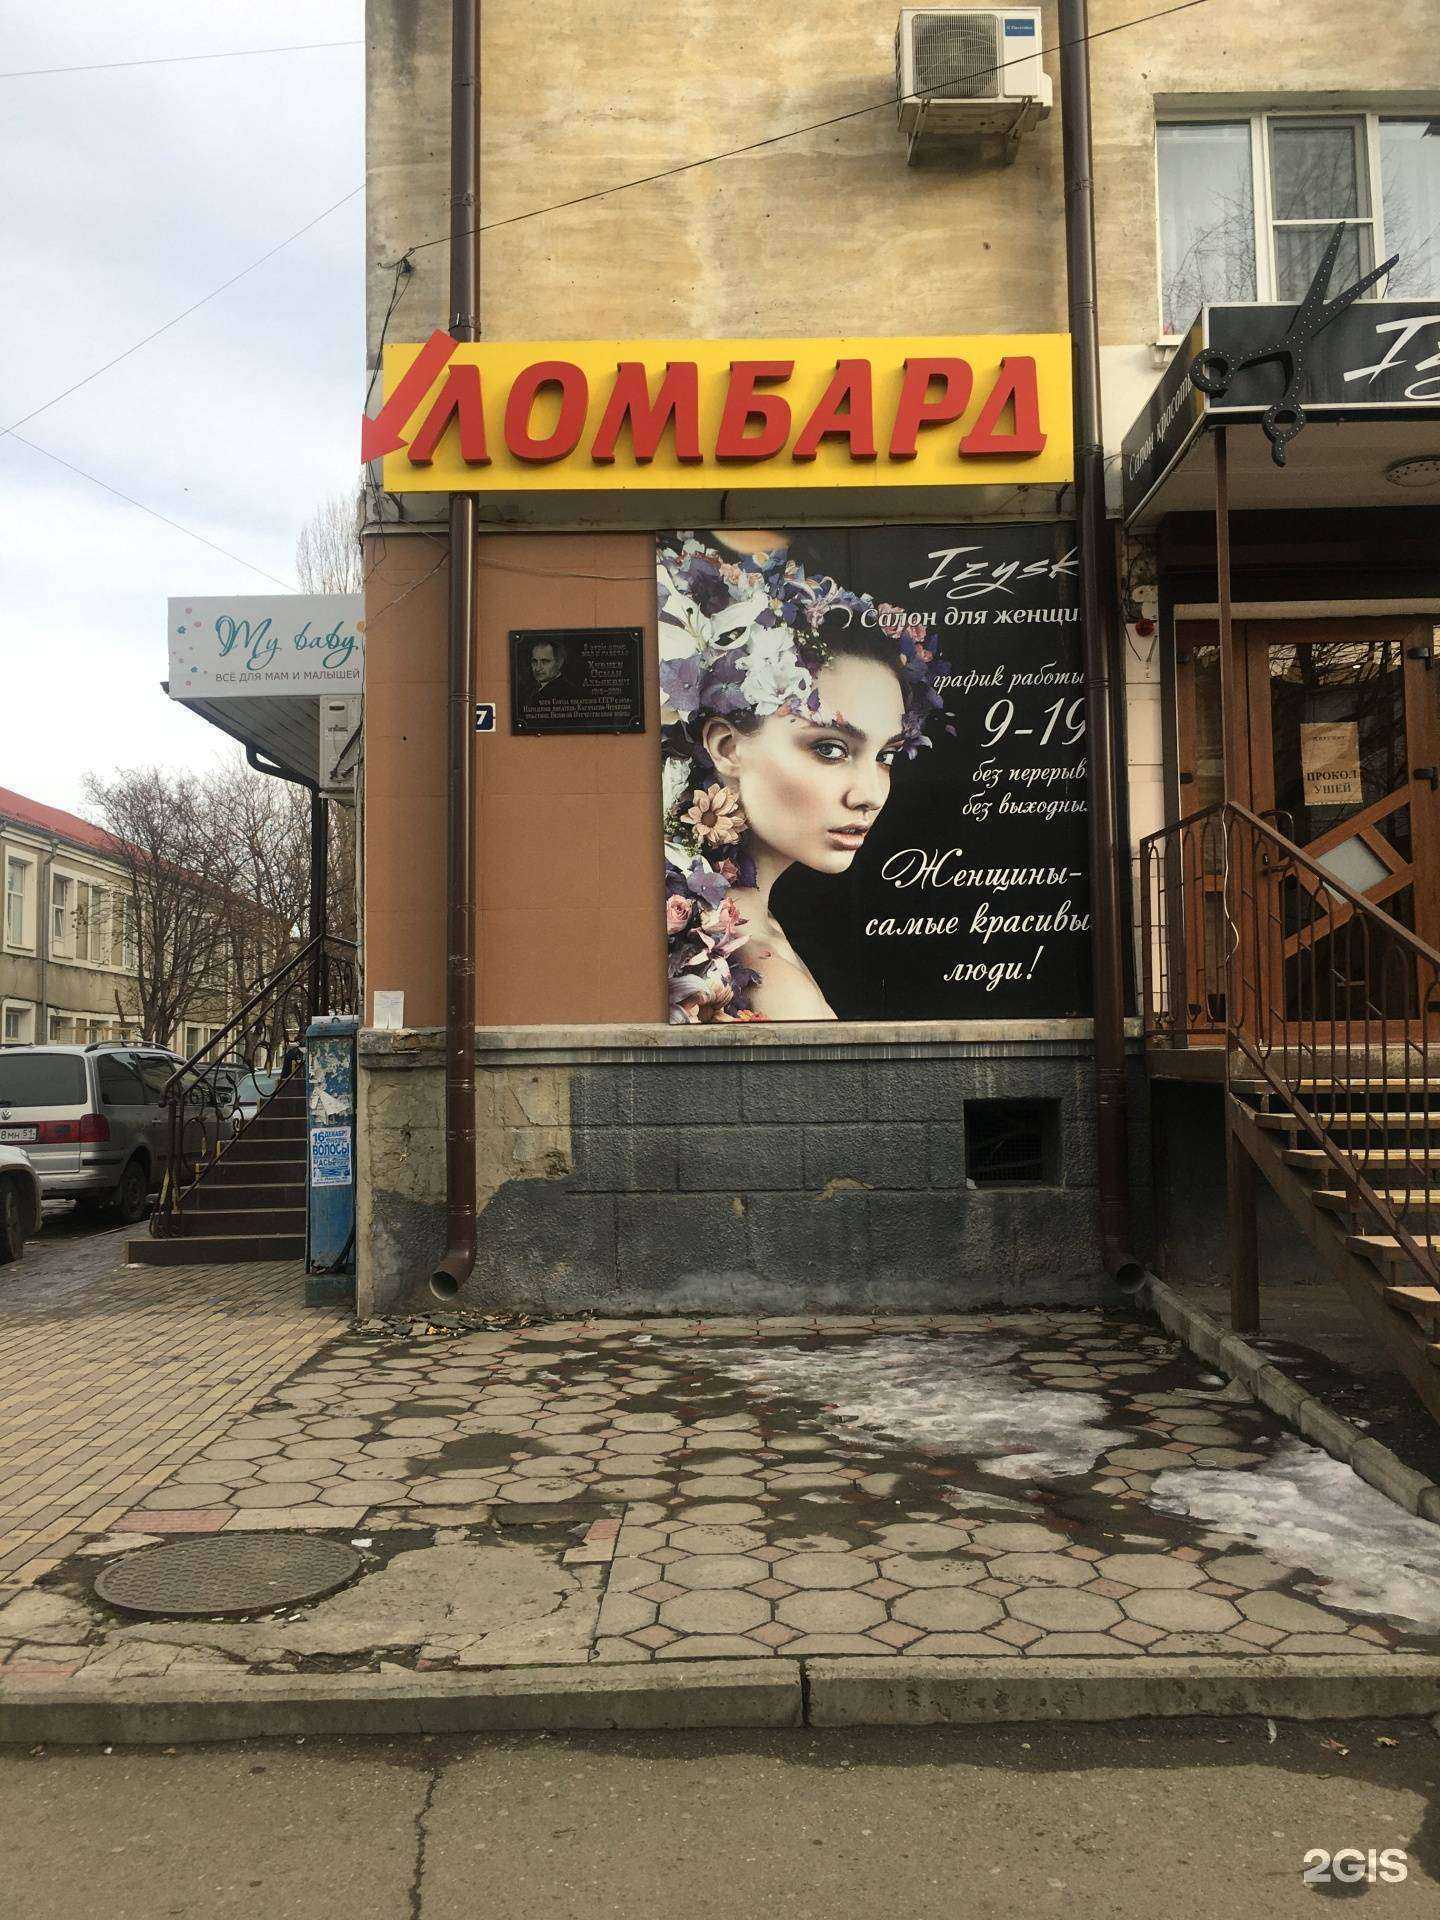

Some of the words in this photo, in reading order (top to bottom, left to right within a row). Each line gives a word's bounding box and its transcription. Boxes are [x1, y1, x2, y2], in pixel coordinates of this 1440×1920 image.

[407, 356, 1048, 466] ЛОМБАРД
[909, 546, 1079, 599] Izysk
[860, 608, 936, 628] Салон
[944, 606, 988, 626] для
[992, 607, 1081, 629] женщи
[215, 615, 282, 671] My
[294, 621, 359, 669] baby
[238, 672, 261, 683] ДЛЯ
[265, 671, 289, 681] МАМ
[292, 671, 300, 680] И
[303, 667, 360, 680] МАЛЫШЕЙ
[932, 664, 1005, 694] график
[1008, 661, 1085, 693] работы
[981, 697, 1087, 748] 9-19
[972, 757, 1003, 789] без
[1008, 757, 1088, 788] перерыв
[1306, 769, 1357, 781] ПРОКОЛ
[962, 790, 993, 822] без
[998, 792, 1088, 821] выходны
[882, 848, 1082, 894] Женщины-
[865, 915, 959, 936] самые
[969, 900, 1092, 945] красивы
[943, 945, 1044, 992] люди!
[313, 1132, 325, 1142] 16
[313, 1143, 350, 1155] ВОЛОСЫ
